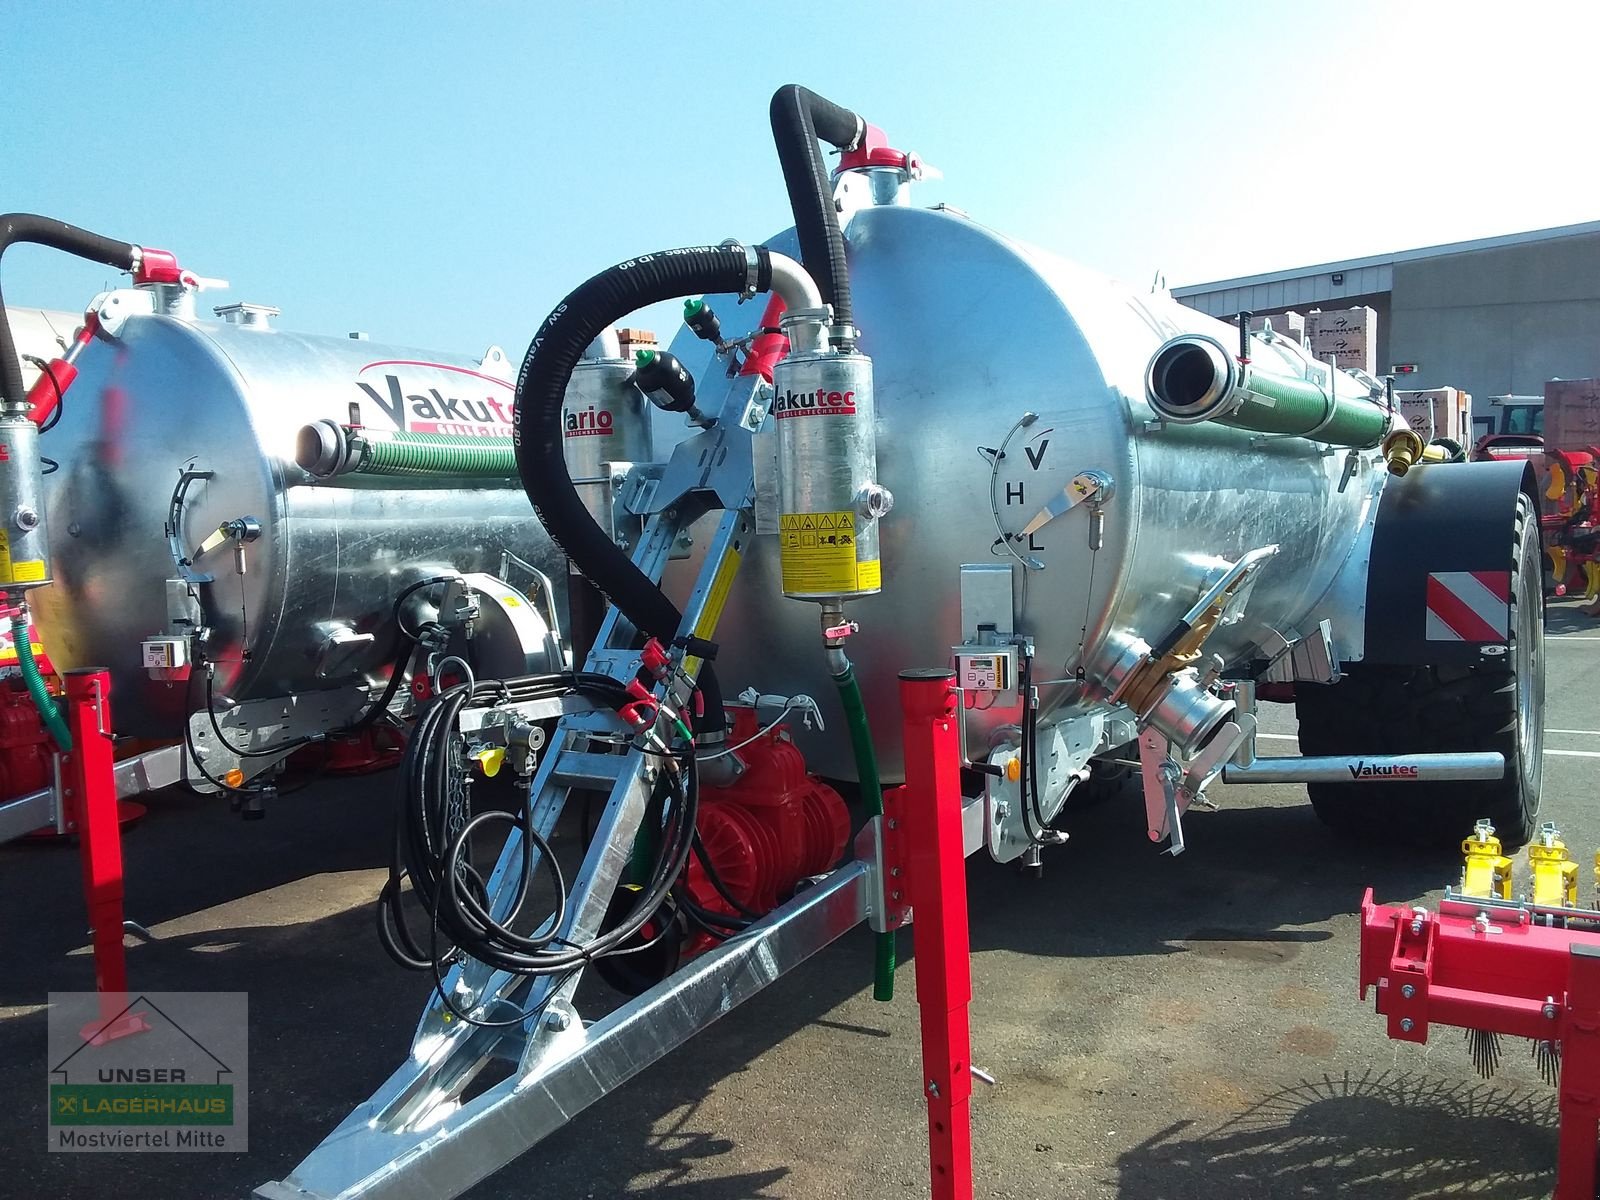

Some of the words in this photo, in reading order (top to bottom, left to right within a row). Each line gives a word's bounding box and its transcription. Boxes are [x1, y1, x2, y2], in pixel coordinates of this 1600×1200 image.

[638, 254, 655, 264] ID
[664, 245, 720, 256] Vakutec
[618, 260, 637, 270] 80
[548, 303, 568, 326] SW
[516, 337, 545, 395] Vakutec
[356, 375, 515, 432] Vakut
[774, 385, 856, 412] akutec
[514, 409, 522, 425] ID
[564, 405, 613, 430] ario
[514, 428, 522, 446] 80
[1024, 439, 1050, 471] V
[1006, 482, 1024, 505] H
[1028, 533, 1045, 551] L
[1348, 760, 1418, 779] Vakutec
